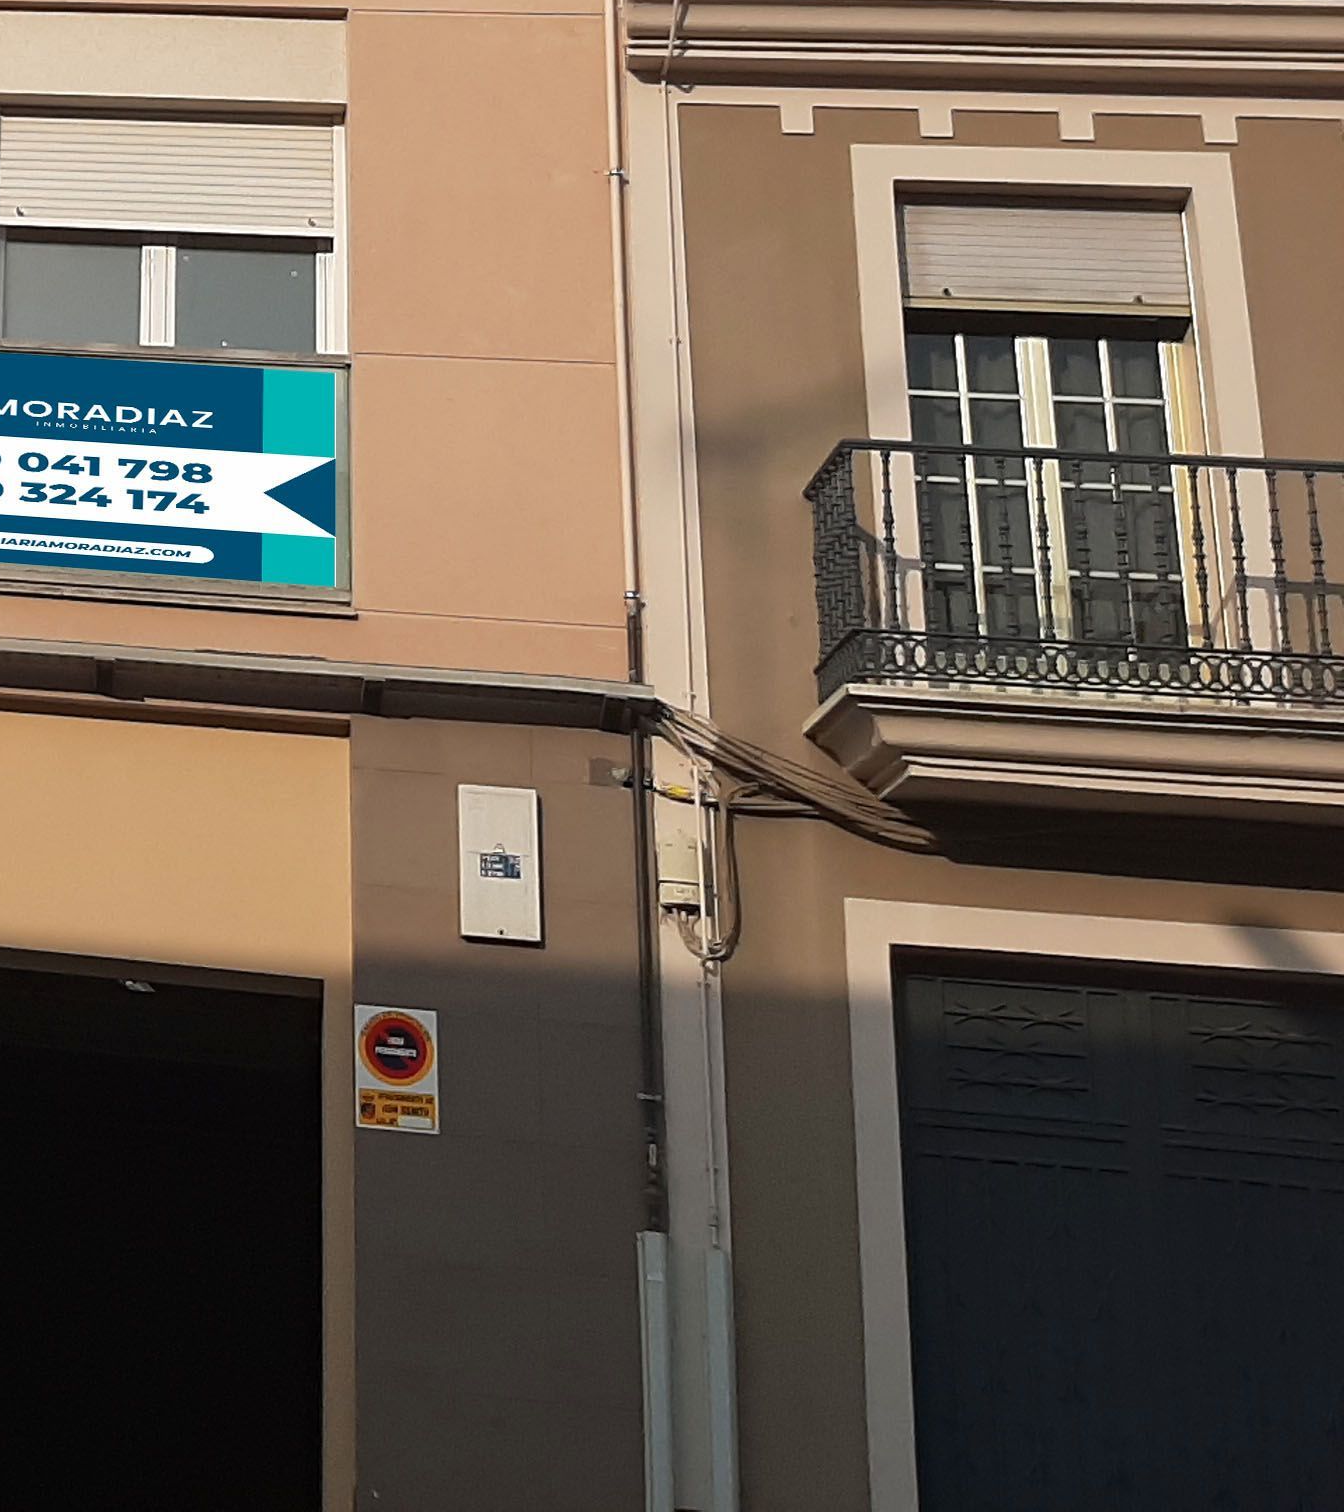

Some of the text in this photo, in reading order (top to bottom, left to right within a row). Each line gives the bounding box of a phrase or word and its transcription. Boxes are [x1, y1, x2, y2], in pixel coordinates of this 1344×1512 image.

[18, 452, 100, 476] 041
[119, 459, 213, 483] 798
[20, 482, 113, 507] 324
[127, 489, 210, 514] 174
